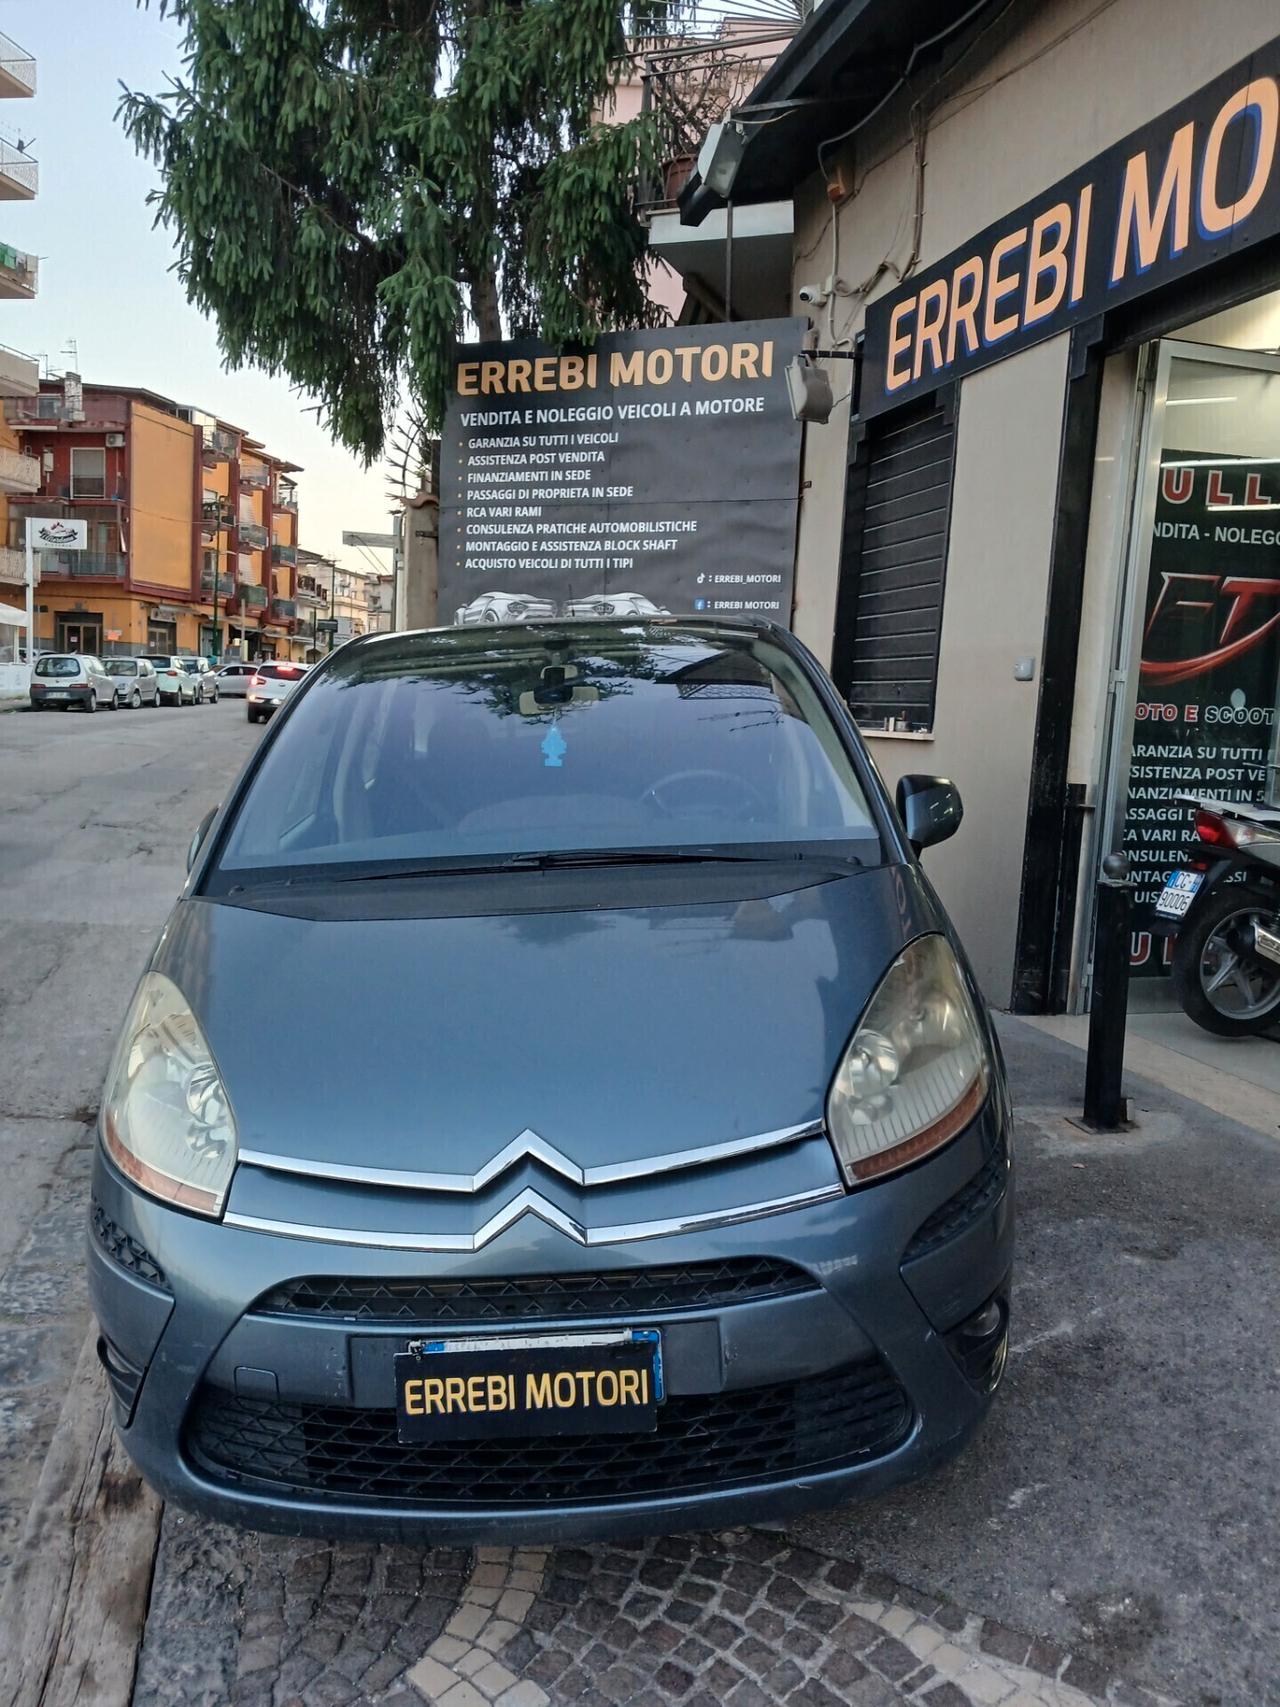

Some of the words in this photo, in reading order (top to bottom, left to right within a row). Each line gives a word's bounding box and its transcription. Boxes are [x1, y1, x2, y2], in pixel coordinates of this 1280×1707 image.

[886, 183, 1093, 392] ERREBI
[1110, 77, 1279, 284] MO
[457, 354, 597, 395] ERREBI
[610, 341, 773, 387] MOTORI
[460, 411, 521, 427] VENDITA
[525, 410, 533, 424] E
[537, 406, 613, 423] NOLEGGIO
[618, 402, 676, 419] VEICOLI
[680, 402, 691, 416] A
[696, 397, 764, 415] MOTORE
[468, 437, 520, 449] GARANZIA
[522, 436, 536, 447] SU
[539, 435, 568, 446] TUTTI
[571, 434, 574, 445] I
[577, 432, 619, 444] VEICOLI
[467, 454, 527, 466] ASSISTENZA
[530, 453, 557, 464] POST
[558, 451, 605, 463] VENDITA
[468, 471, 548, 483] FINANZIAMENTI
[551, 471, 563, 481] IN
[565, 469, 591, 480] SEDE
[467, 489, 516, 500] PASSAGGI
[518, 489, 529, 499] DI
[532, 488, 590, 499] PROPRIETA
[592, 487, 604, 497] IN
[606, 486, 633, 497] SEDE
[467, 507, 487, 517] RCA
[489, 507, 512, 517] VARI
[515, 506, 542, 517] RAMI
[466, 524, 534, 534] CONSULENZA
[536, 523, 587, 534] PRATICHE
[589, 521, 697, 533] AUTOMOBILISTICHE
[466, 541, 529, 551] MONTAGGIO
[532, 541, 538, 551] E
[540, 541, 602, 551] ASSISTENZA
[604, 540, 640, 551] BLOCK
[642, 539, 678, 550] SHAFT
[465, 558, 516, 570] ACQUISTO
[518, 558, 558, 569] VEICOLI
[561, 558, 572, 568] DI
[574, 558, 604, 568] TUTTI
[607, 558, 610, 568] I
[612, 558, 633, 568] TIPI
[715, 575, 781, 584] ERREBI_MOTORI
[714, 601, 743, 609] ERREBI
[744, 601, 779, 609] MOTORI
[1184, 704, 1199, 722] E
[1197, 746, 1217, 759] SU
[1221, 747, 1263, 760] TUTTI
[1206, 767, 1244, 780] POST
[1236, 789, 1252, 801] IN
[1142, 829, 1176, 841] VARI
[1134, 891, 1160, 903] UIS
[404, 1374, 516, 1416] ERREBI
[526, 1369, 649, 1409] MOTORI
